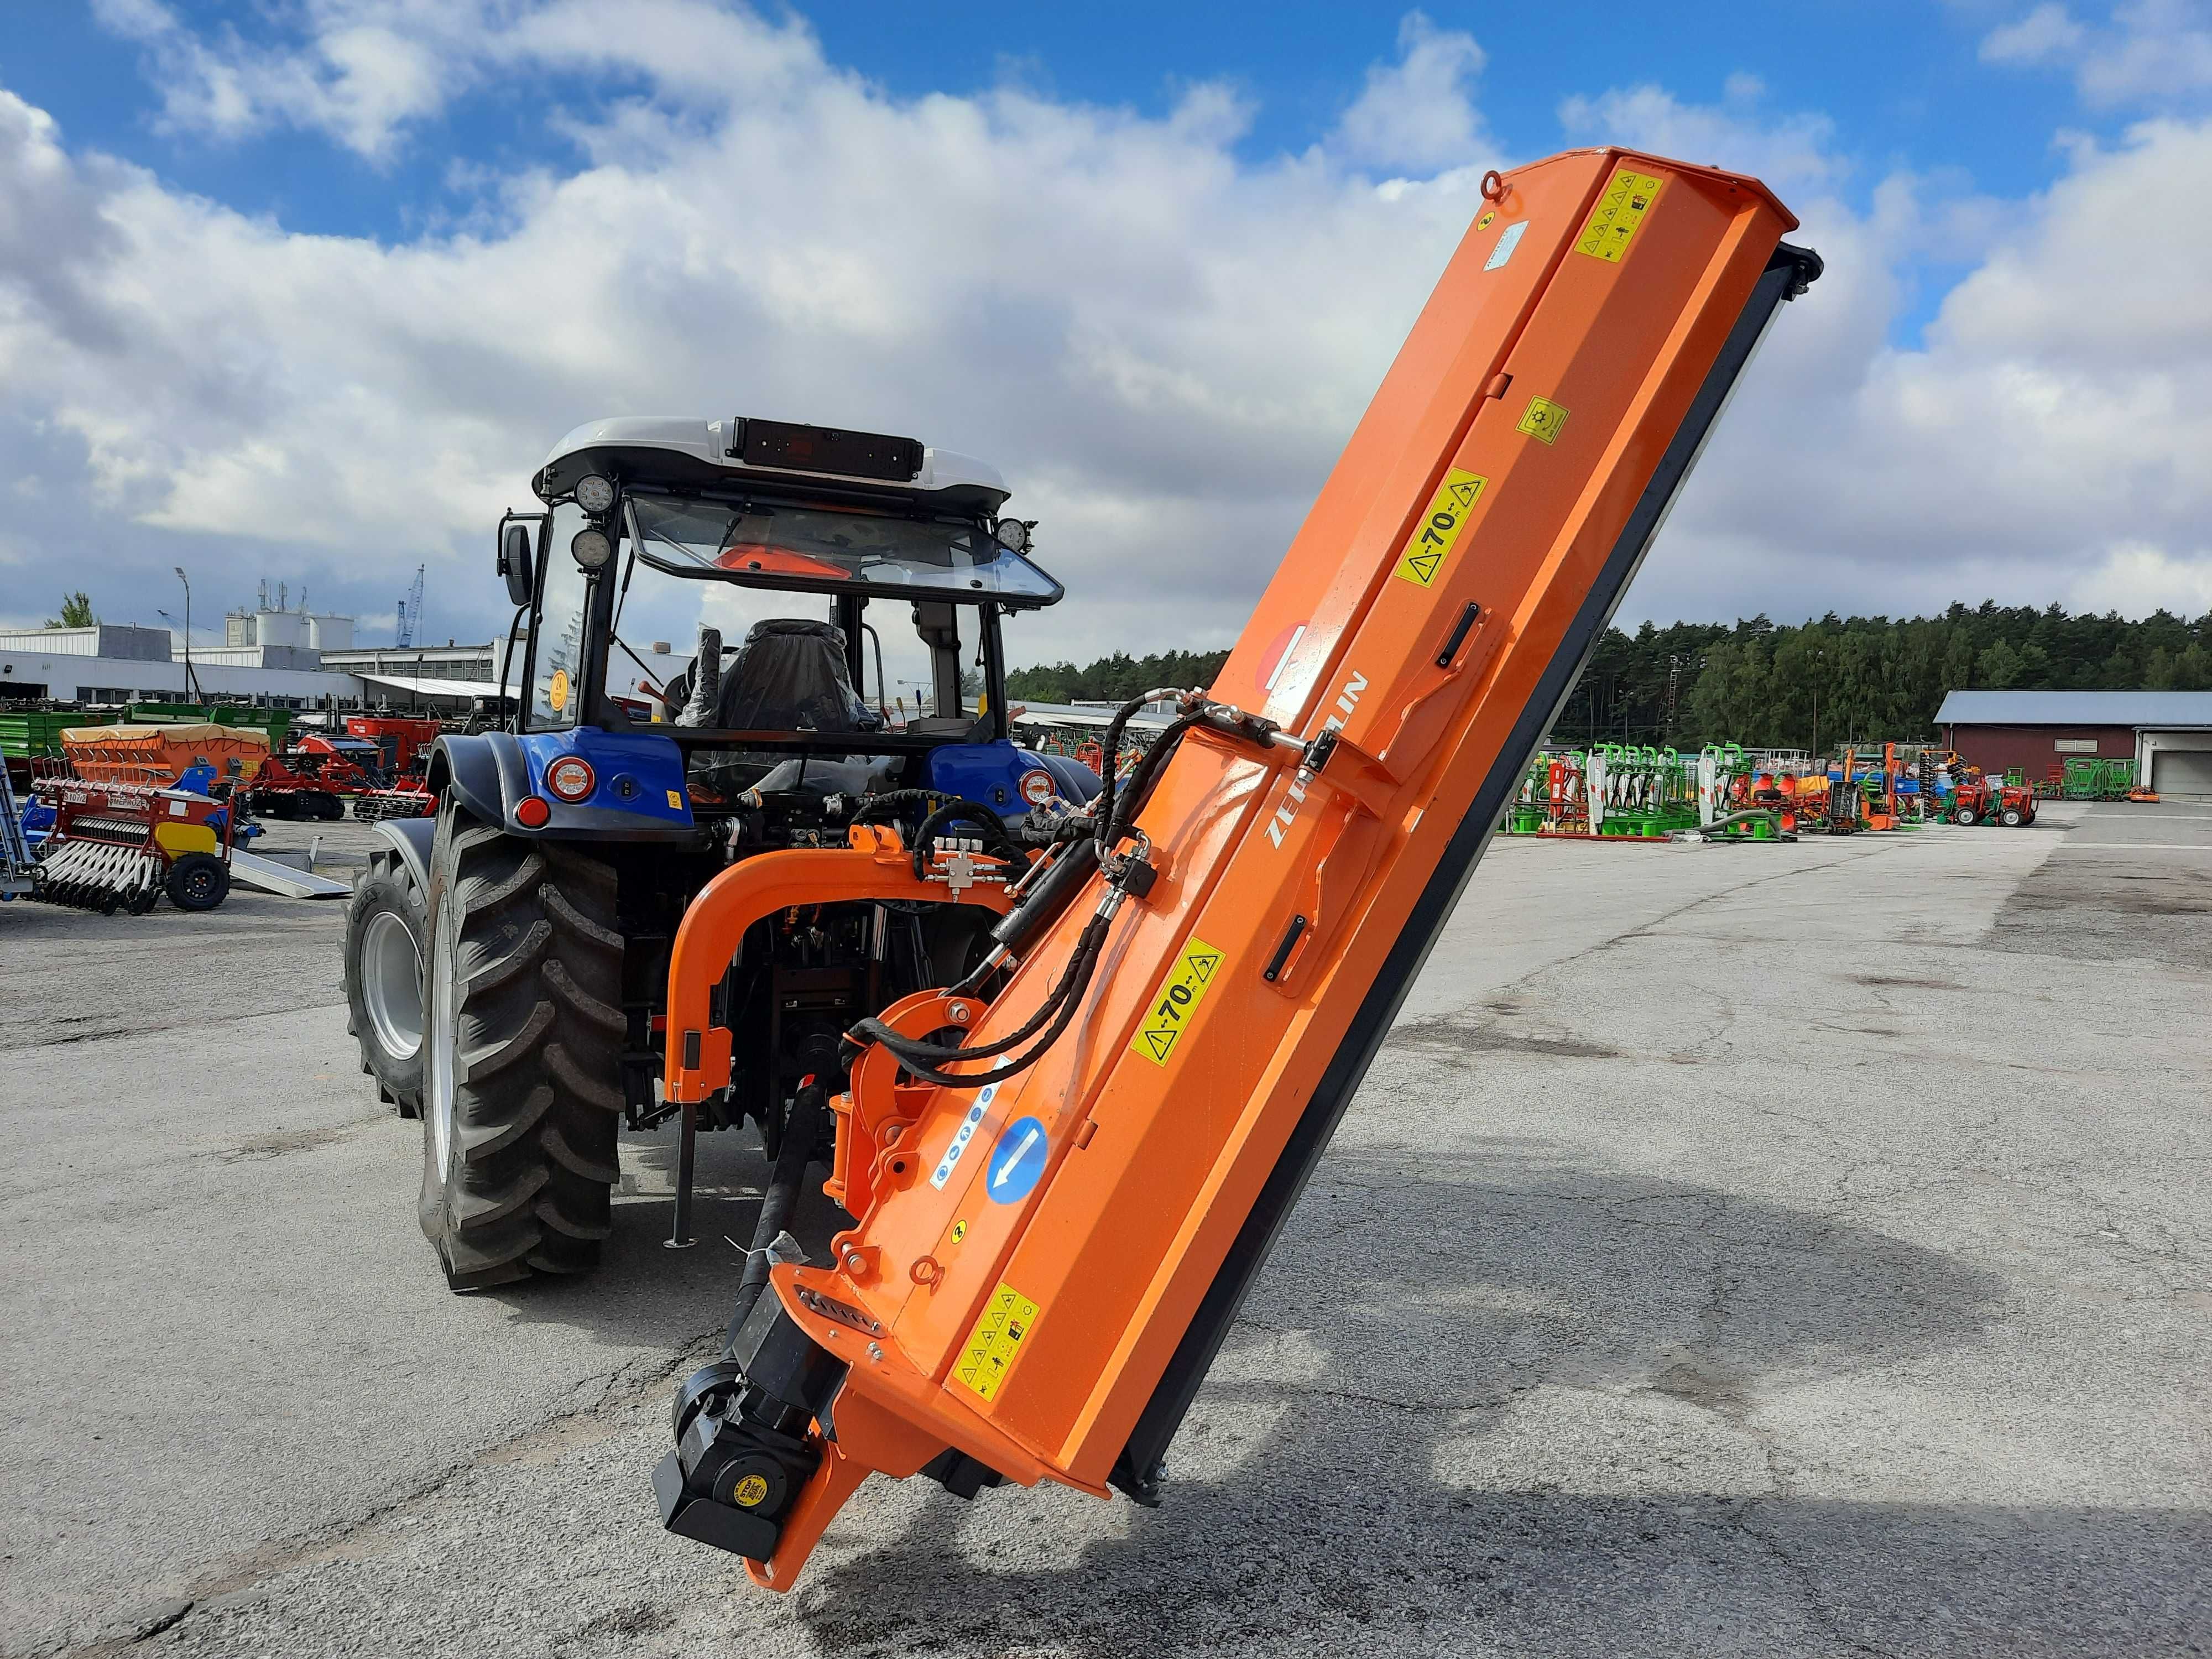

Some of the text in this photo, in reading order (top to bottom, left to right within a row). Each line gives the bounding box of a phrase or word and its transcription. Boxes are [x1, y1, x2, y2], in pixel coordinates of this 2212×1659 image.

[1421, 512, 1455, 546] 70
[1157, 984, 1192, 1021] 70
[740, 1479, 752, 1498] STOP
